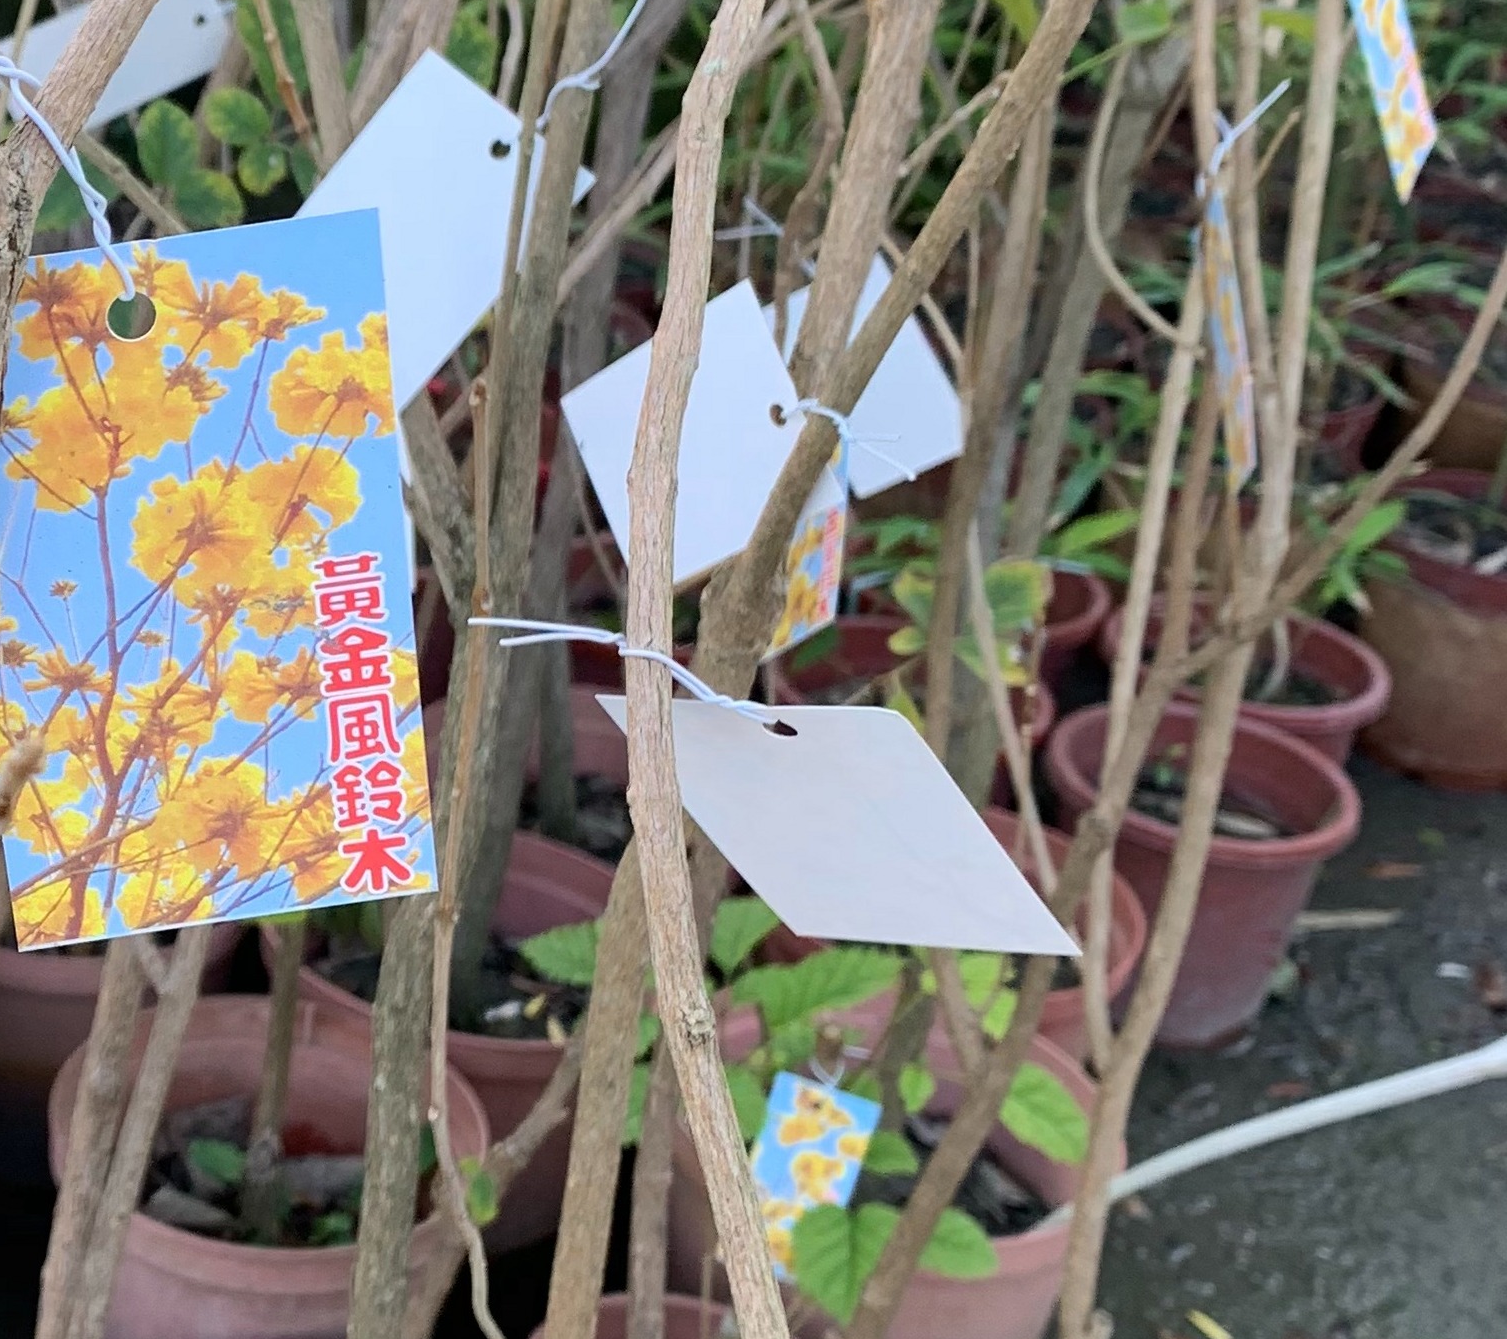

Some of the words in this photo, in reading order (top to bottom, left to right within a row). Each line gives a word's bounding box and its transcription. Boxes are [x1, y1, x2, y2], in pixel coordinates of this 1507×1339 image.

[313, 555, 413, 891] 黃金風鈴木
